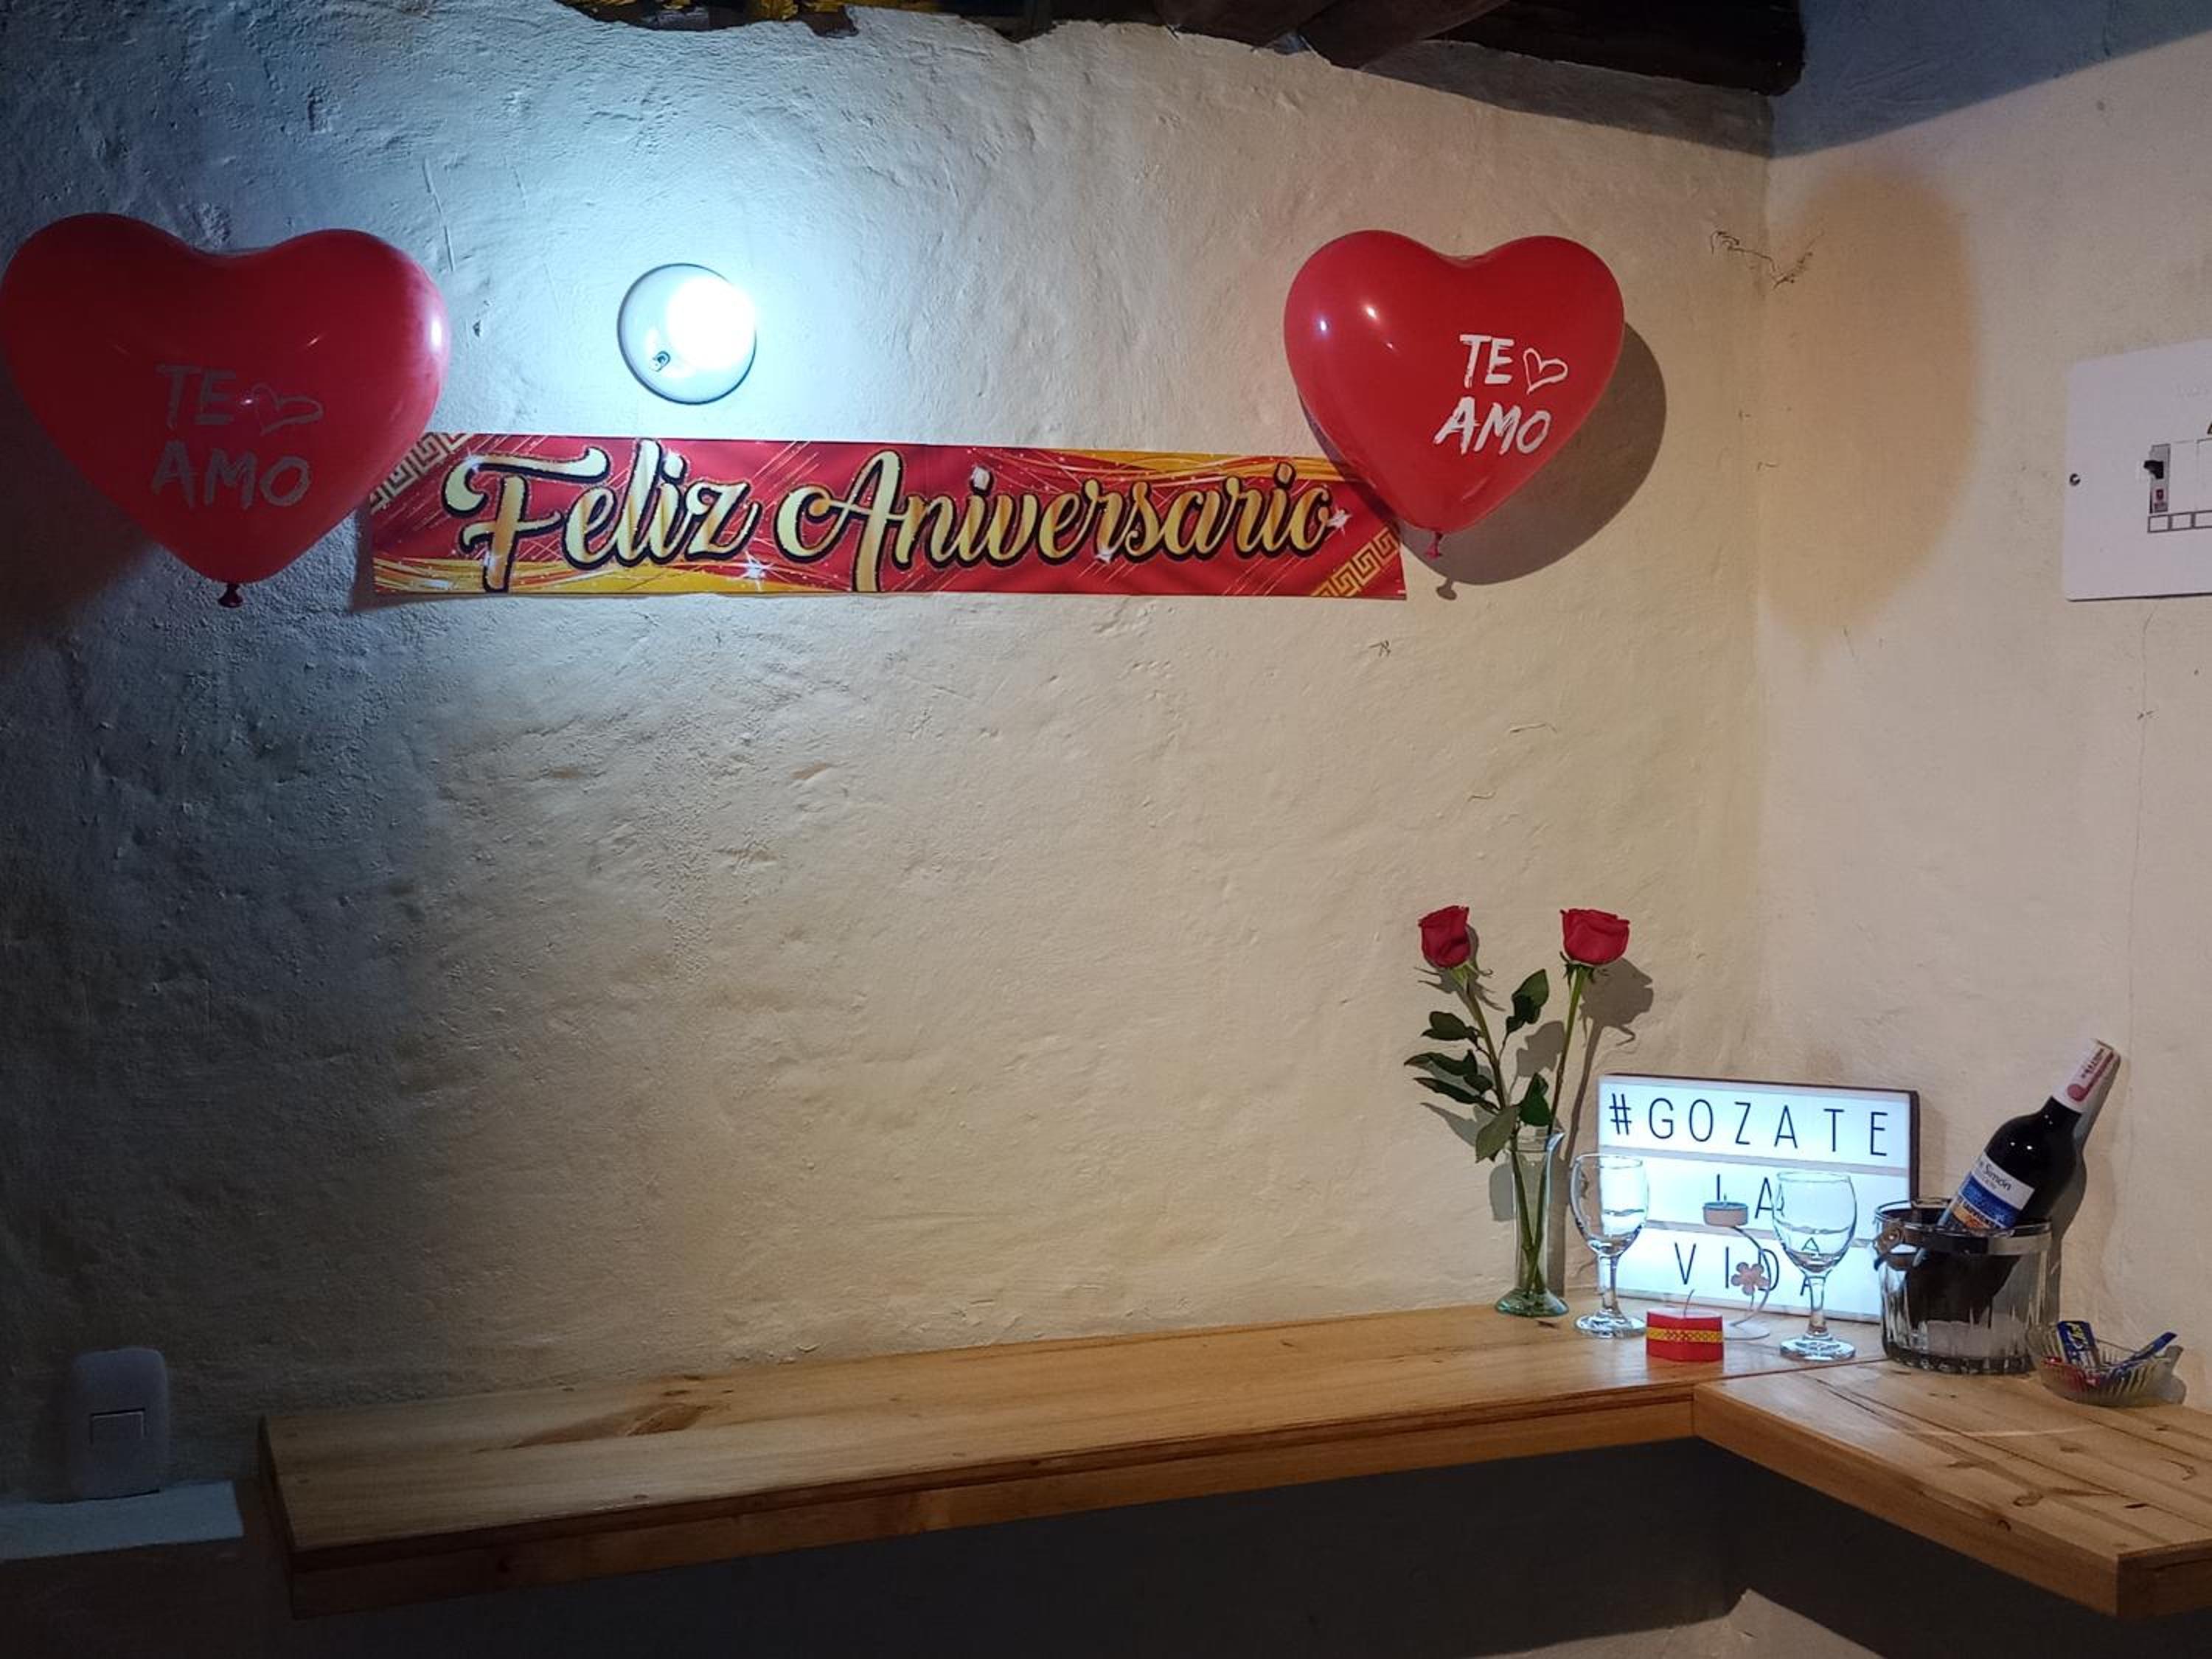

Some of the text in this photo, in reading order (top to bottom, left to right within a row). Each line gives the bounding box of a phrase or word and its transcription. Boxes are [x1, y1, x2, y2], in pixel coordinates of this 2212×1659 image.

[1459, 334, 1515, 388] TE
[156, 365, 237, 429] TE
[1434, 396, 1552, 455] AMO
[152, 440, 311, 509] AMO
[442, 437, 1332, 592] Feliz Aniversario
[1609, 1093, 1888, 1157] #GOZATE
